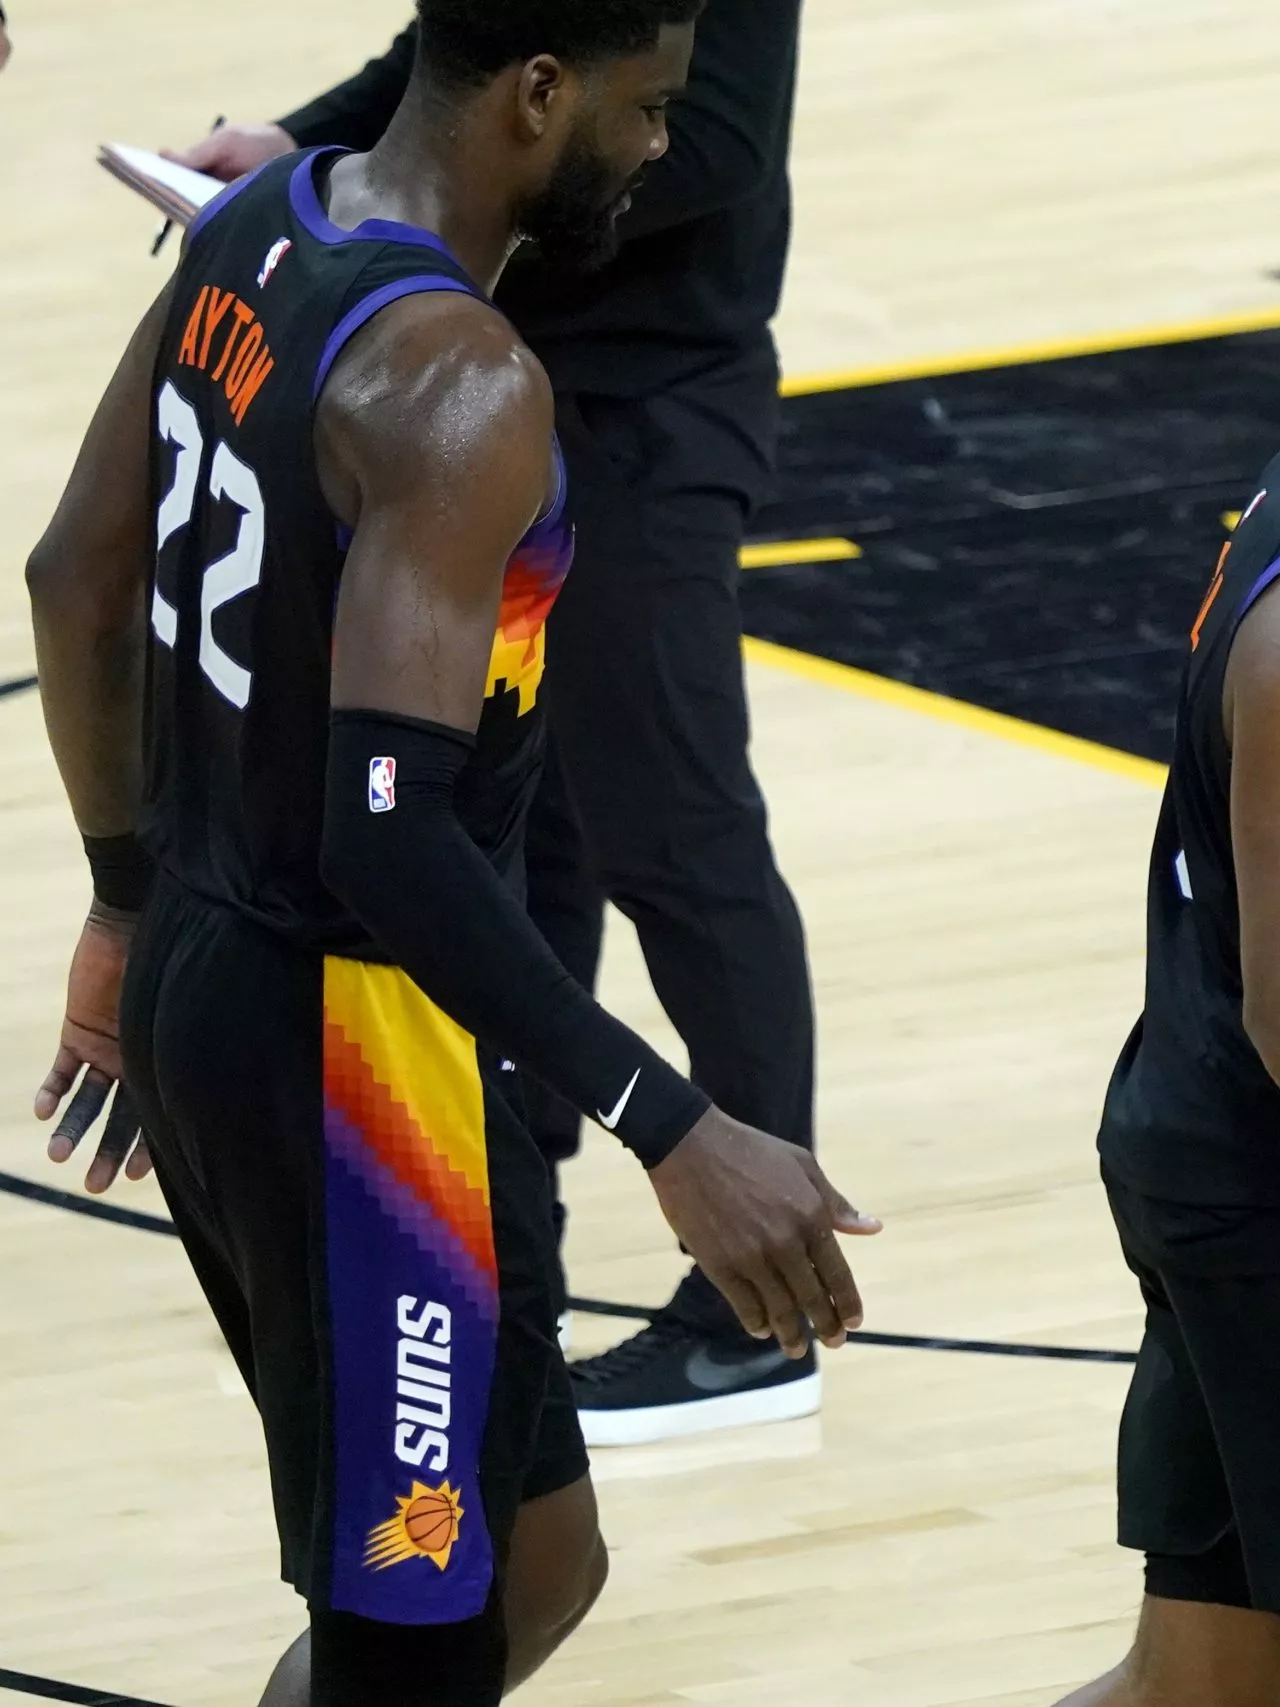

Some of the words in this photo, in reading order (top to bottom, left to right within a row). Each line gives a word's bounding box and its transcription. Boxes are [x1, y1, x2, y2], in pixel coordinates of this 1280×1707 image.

[178, 285, 275, 427] AYTON
[152, 377, 266, 711] 22
[395, 1294, 452, 1472] SUNS
